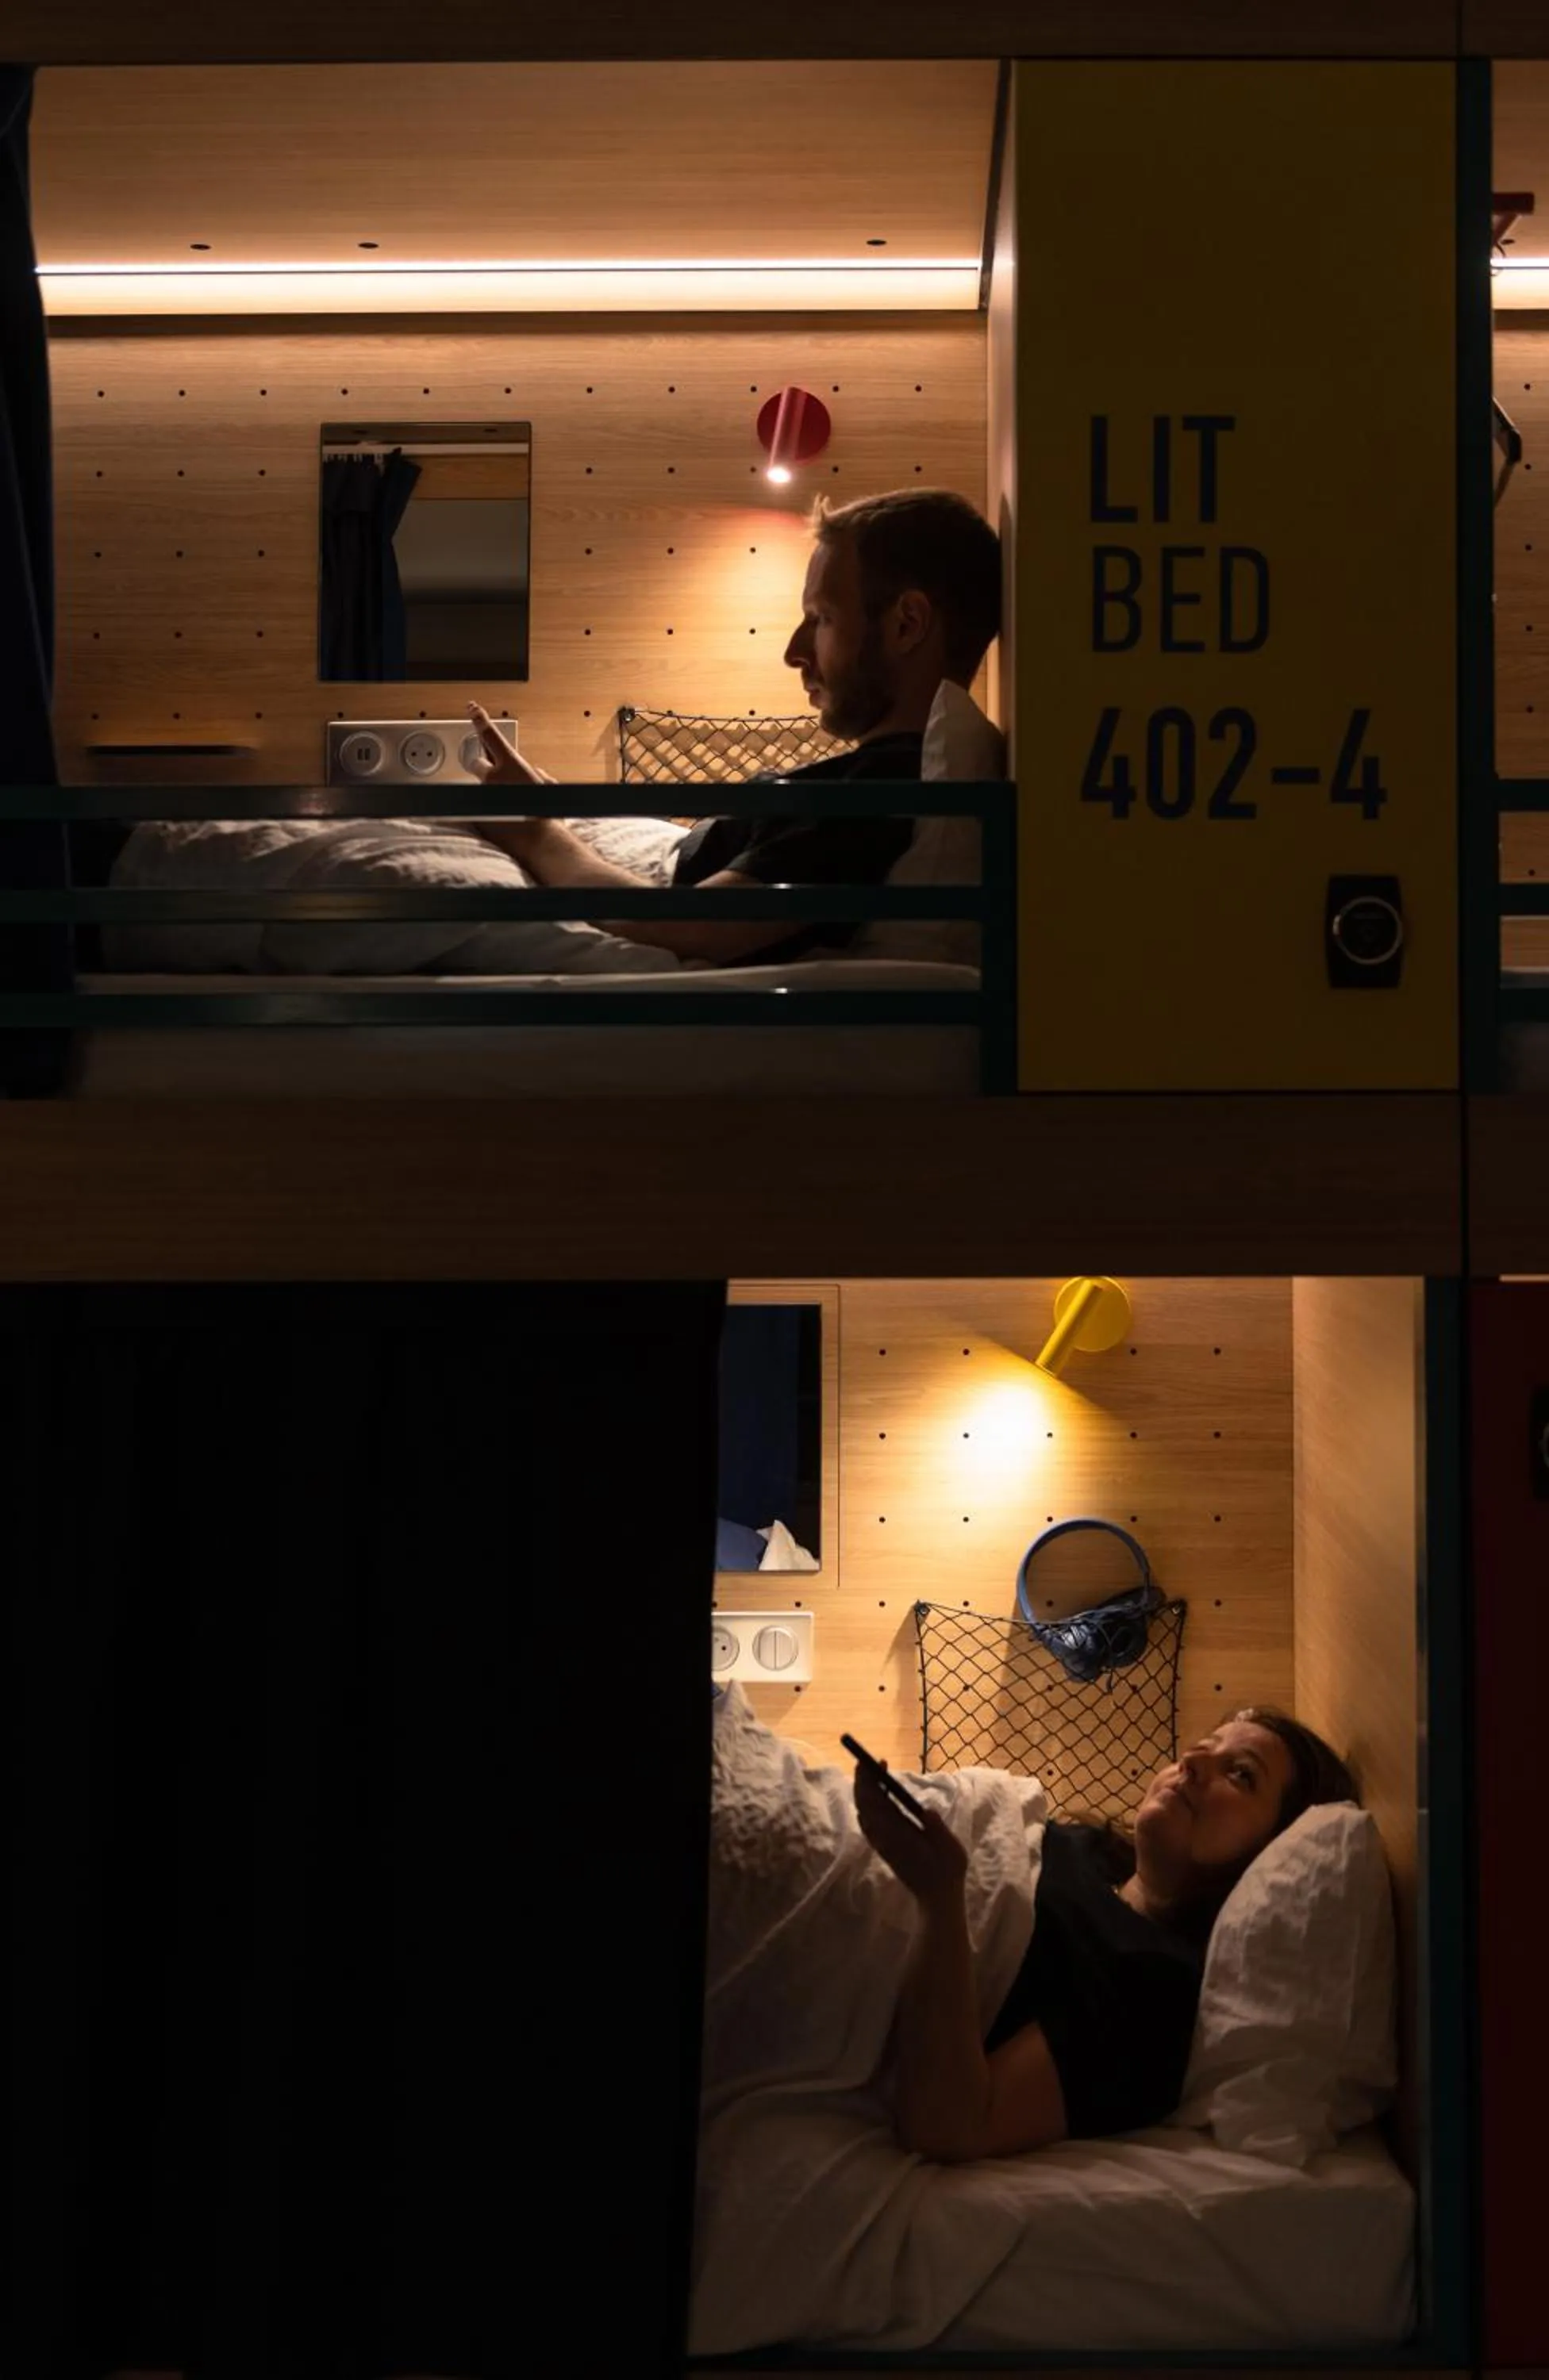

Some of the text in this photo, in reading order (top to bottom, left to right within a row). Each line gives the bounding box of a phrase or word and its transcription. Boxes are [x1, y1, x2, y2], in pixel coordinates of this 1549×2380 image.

[1090, 416, 1236, 523] LIT
[1093, 547, 1270, 652] BED
[1081, 708, 1387, 820] 402-4
